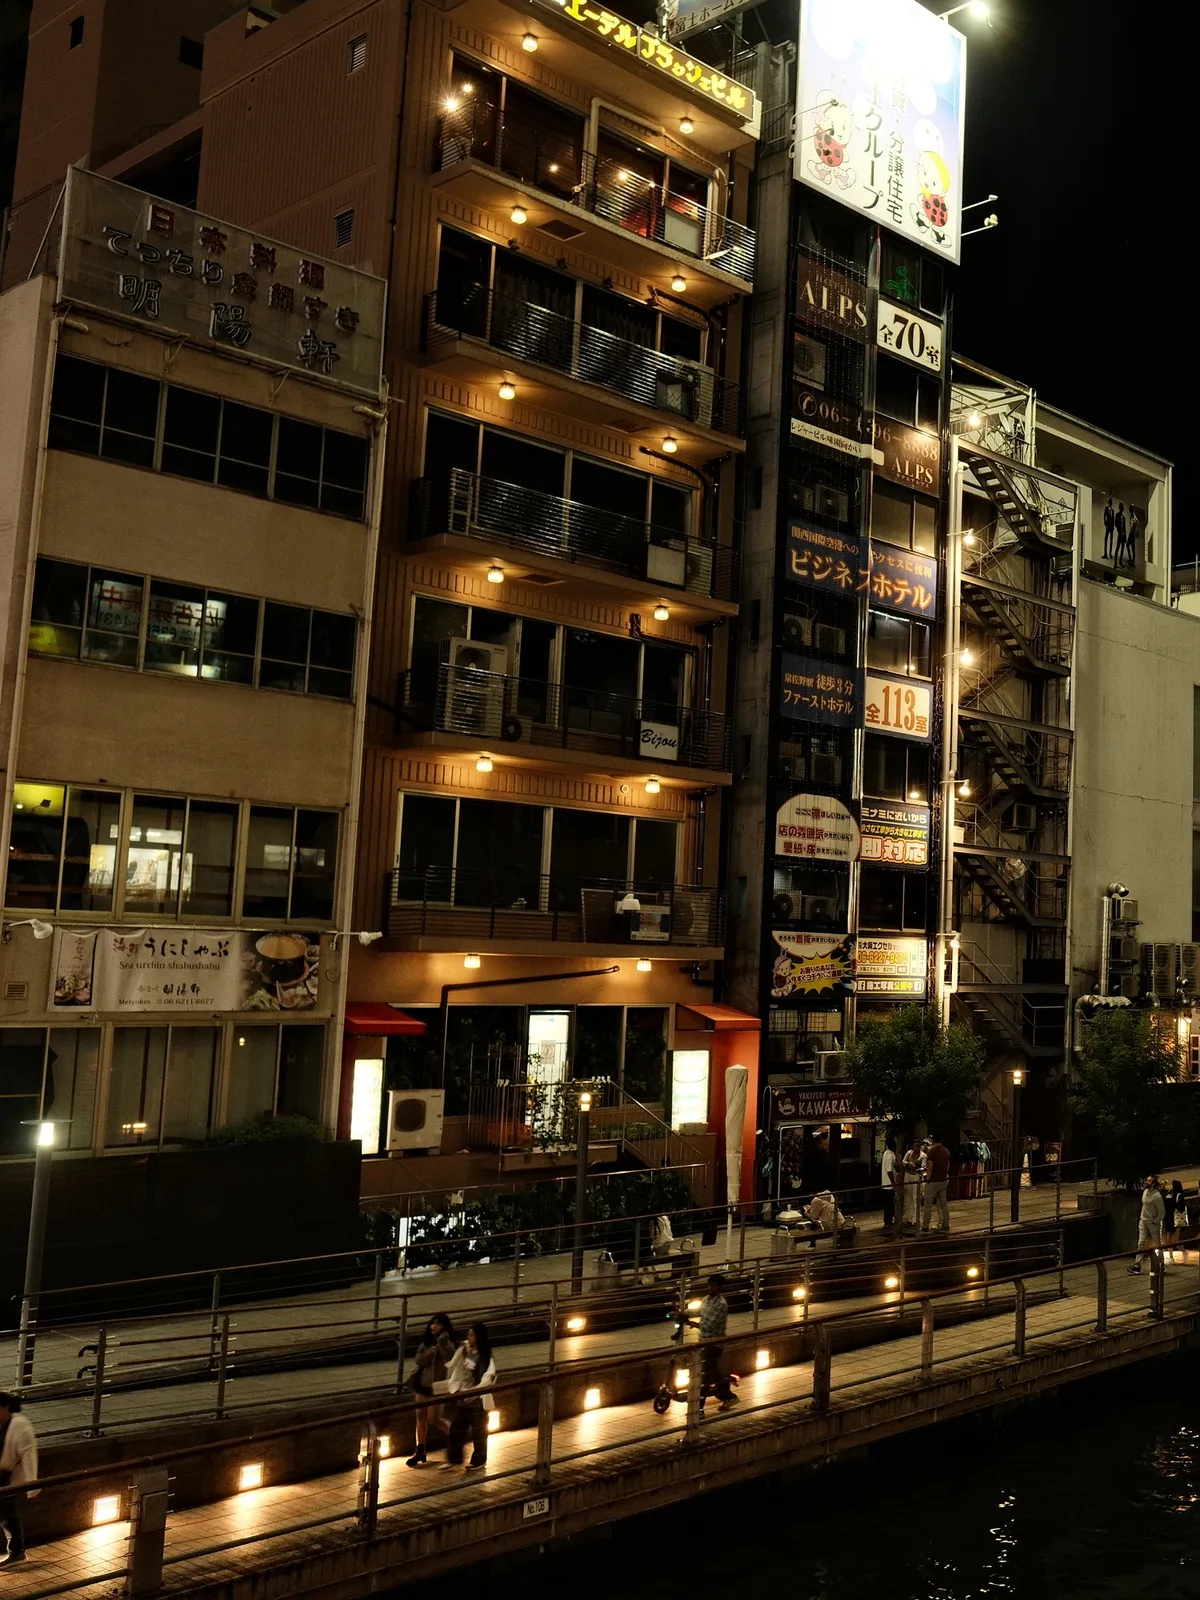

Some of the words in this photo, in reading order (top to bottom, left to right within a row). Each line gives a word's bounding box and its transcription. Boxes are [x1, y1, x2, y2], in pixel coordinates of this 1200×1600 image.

[675, 0, 748, 34] 富士ホーム
[799, 280, 868, 327] ALPS
[118, 274, 340, 374] 明陽軒
[879, 314, 940, 367] 全70室
[891, 457, 934, 484] ALPS
[789, 547, 933, 611] ビジネスホテル
[784, 689, 854, 714] ファーストホテル
[866, 685, 928, 733] 全113室
[641, 729, 677, 750] Bijou
[861, 807, 927, 824] ミナミに近いから
[861, 836, 927, 864] 即対応
[119, 961, 134, 970] Sea
[136, 961, 166, 970] urchin
[167, 961, 221, 971] shabushabu
